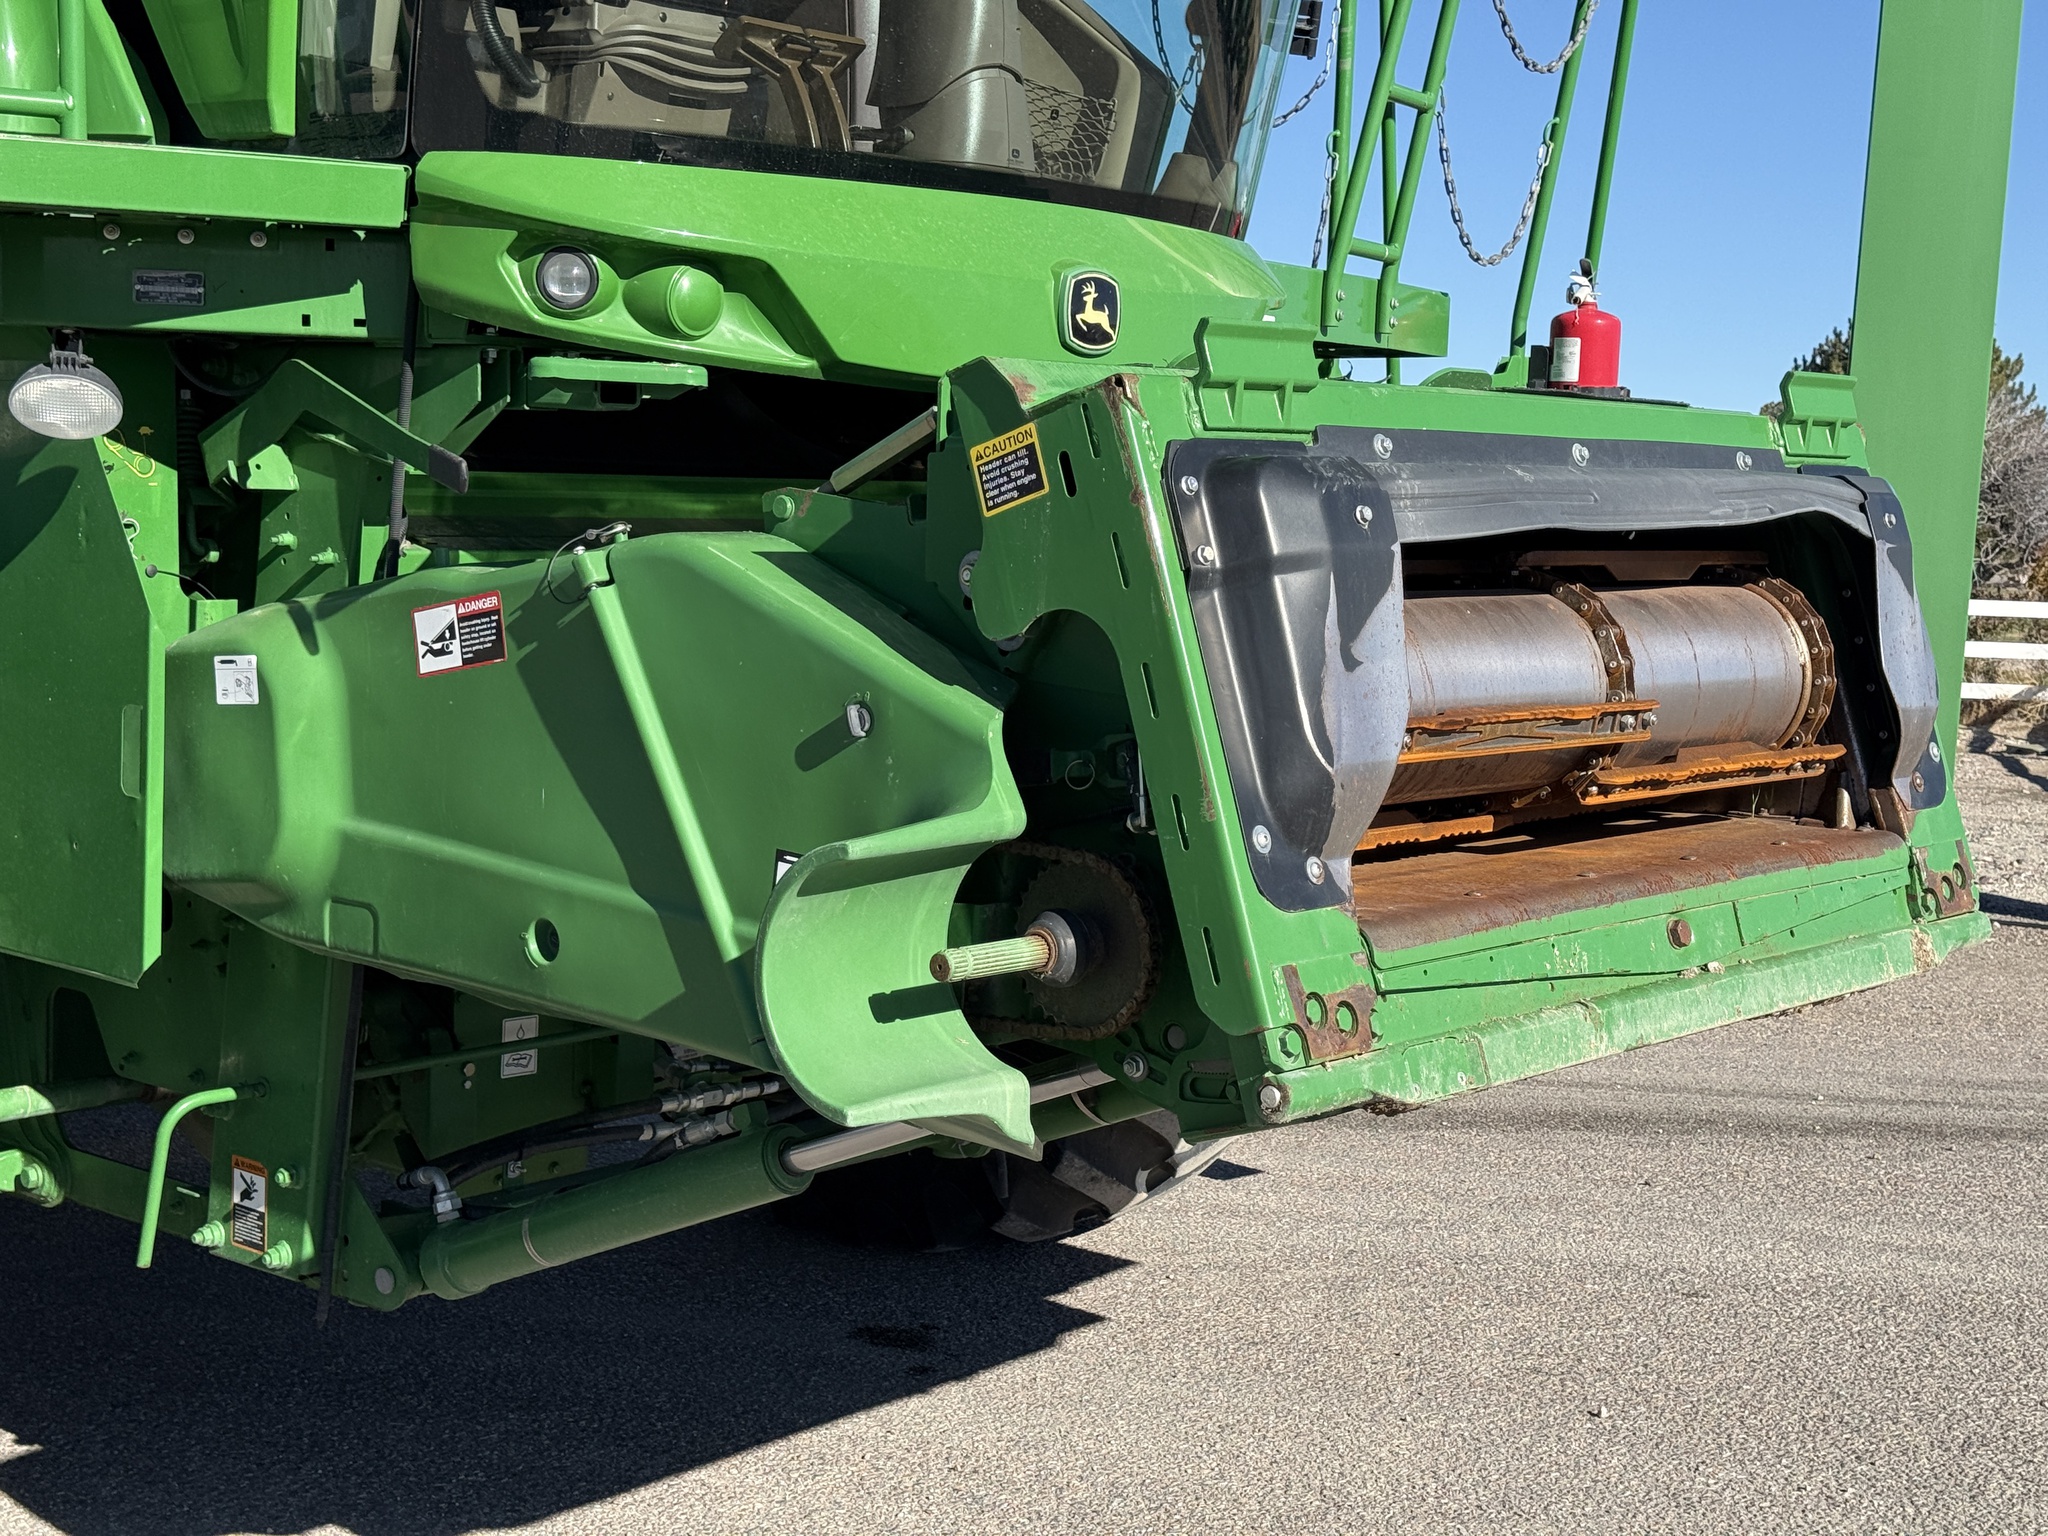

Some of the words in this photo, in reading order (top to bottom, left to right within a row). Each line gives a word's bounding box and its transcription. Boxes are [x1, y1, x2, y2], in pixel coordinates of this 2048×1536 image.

[983, 427, 1033, 458] CAUTION
[979, 459, 1003, 473] Header
[1005, 453, 1016, 463] can
[1017, 448, 1029, 457] tilt.
[982, 470, 1000, 482] Avoid
[1001, 457, 1029, 473] crushing
[1010, 468, 1025, 479] Stay
[986, 488, 1000, 498] clear
[1001, 481, 1017, 492] when
[1017, 473, 1037, 485] engine
[994, 490, 1020, 504] running.
[465, 596, 498, 612] DANGER
[240, 1161, 265, 1174] WARNING
